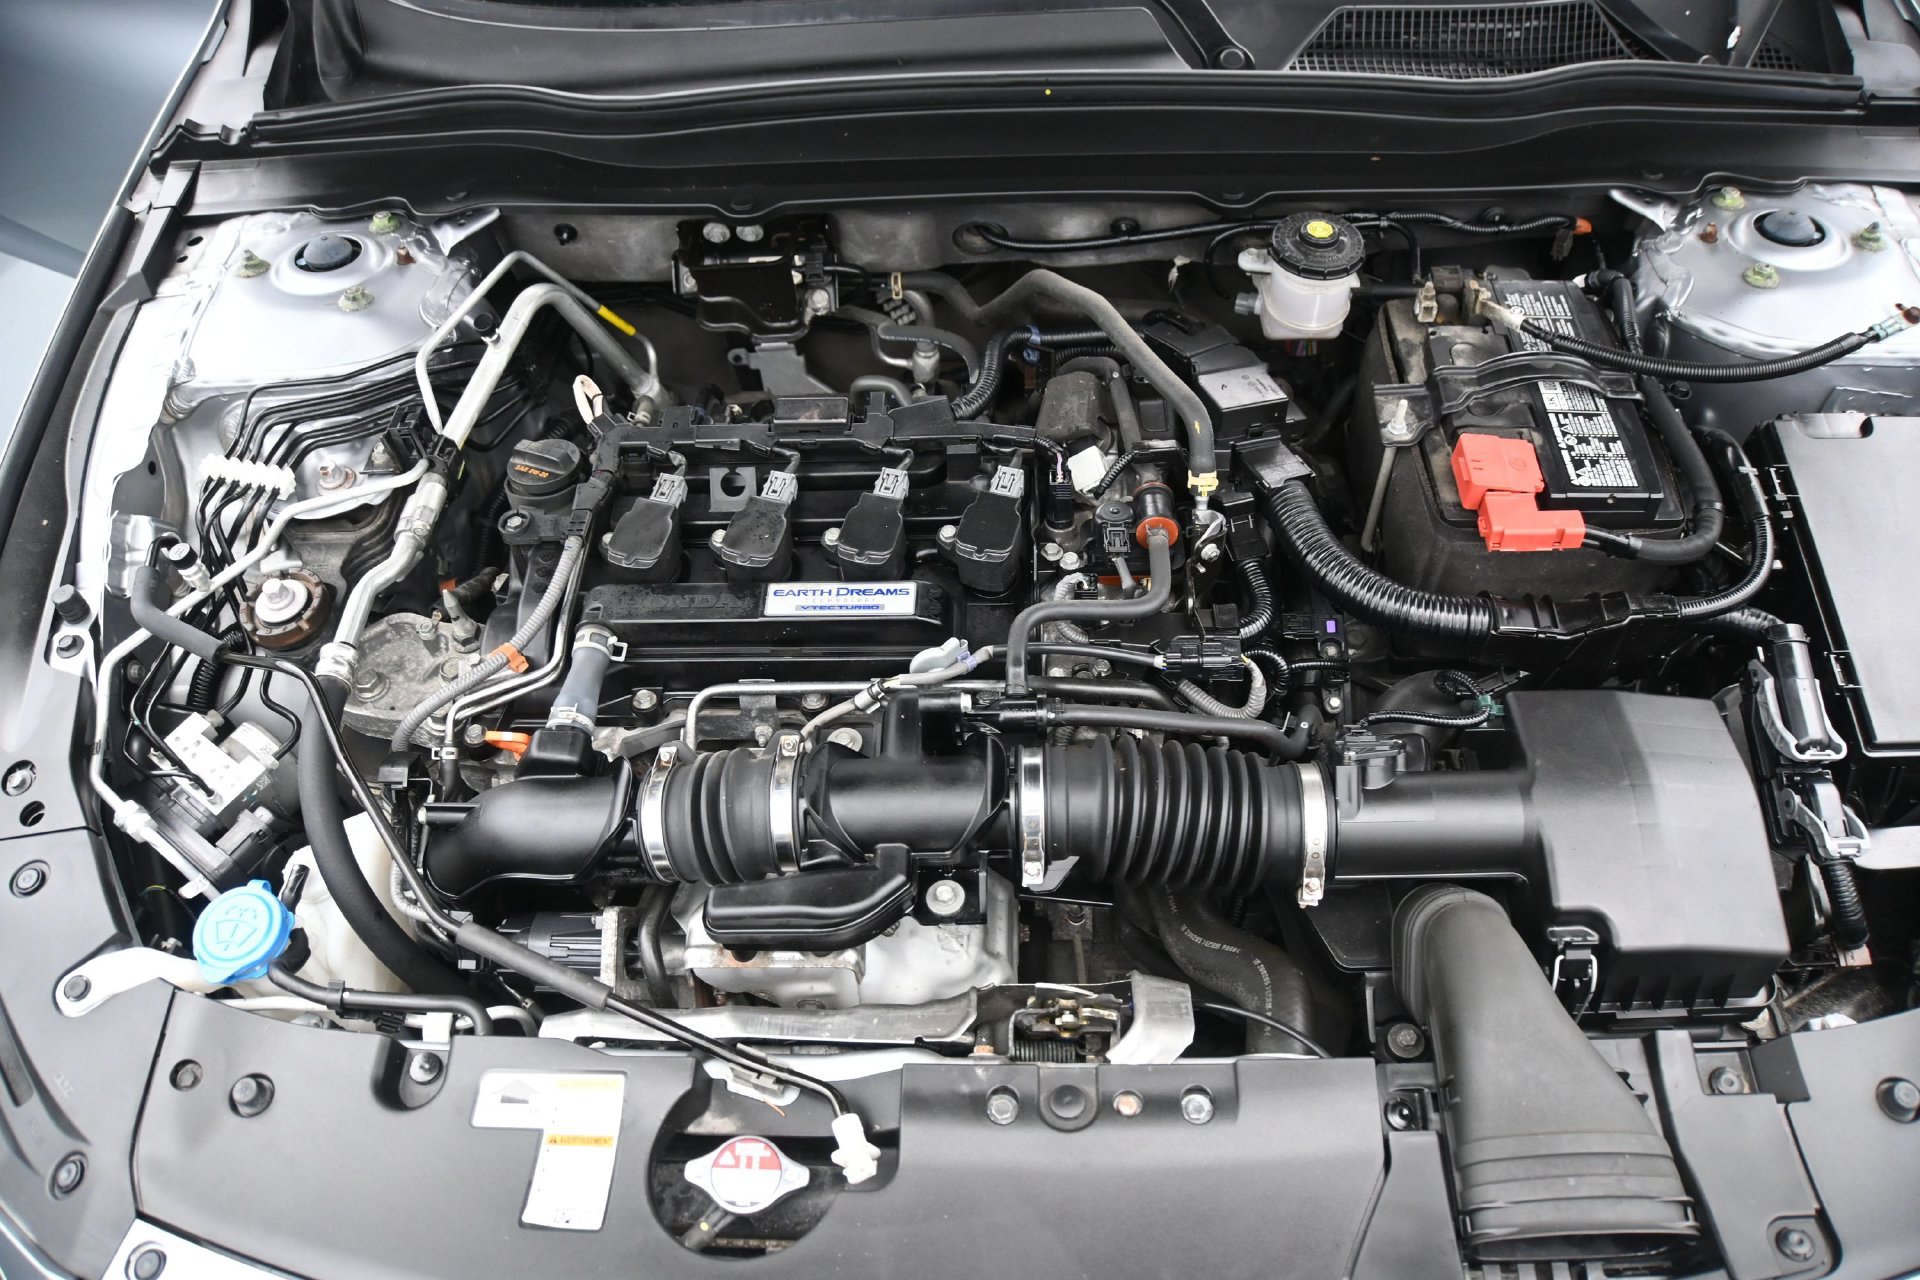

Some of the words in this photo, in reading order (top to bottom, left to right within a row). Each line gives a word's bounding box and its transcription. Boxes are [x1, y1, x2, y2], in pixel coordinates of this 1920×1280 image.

[514, 464, 529, 473] SAE
[773, 588, 832, 597] EARTH
[836, 587, 910, 597] DREAMS
